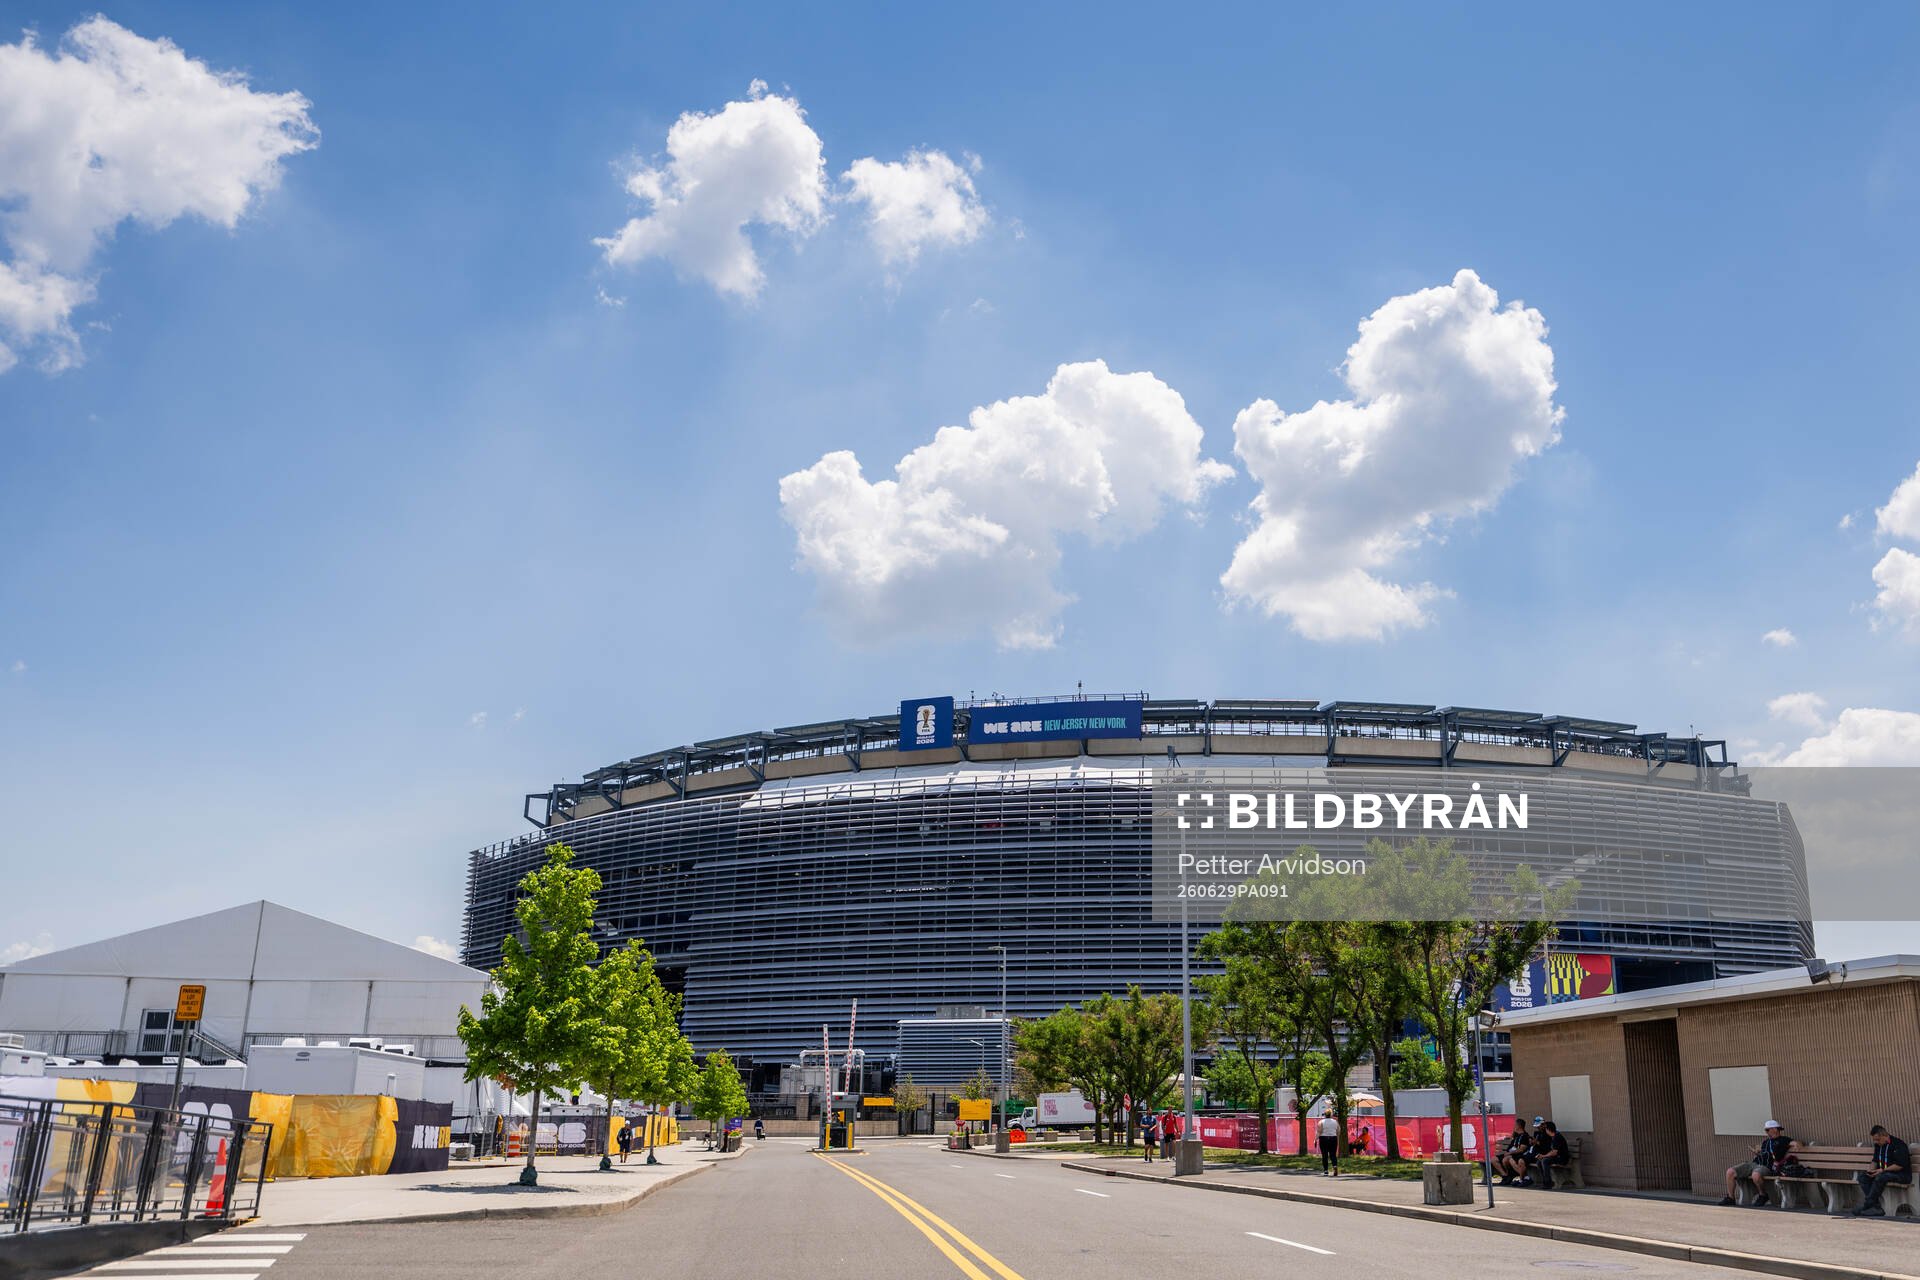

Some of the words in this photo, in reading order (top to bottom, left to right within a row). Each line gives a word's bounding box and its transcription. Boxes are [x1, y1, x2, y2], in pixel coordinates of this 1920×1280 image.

[984, 722, 1008, 734] WE
[1010, 720, 1042, 733] ARE
[1044, 720, 1060, 731] NEW
[1061, 718, 1088, 730] JERSEY
[1089, 718, 1106, 729] NEW
